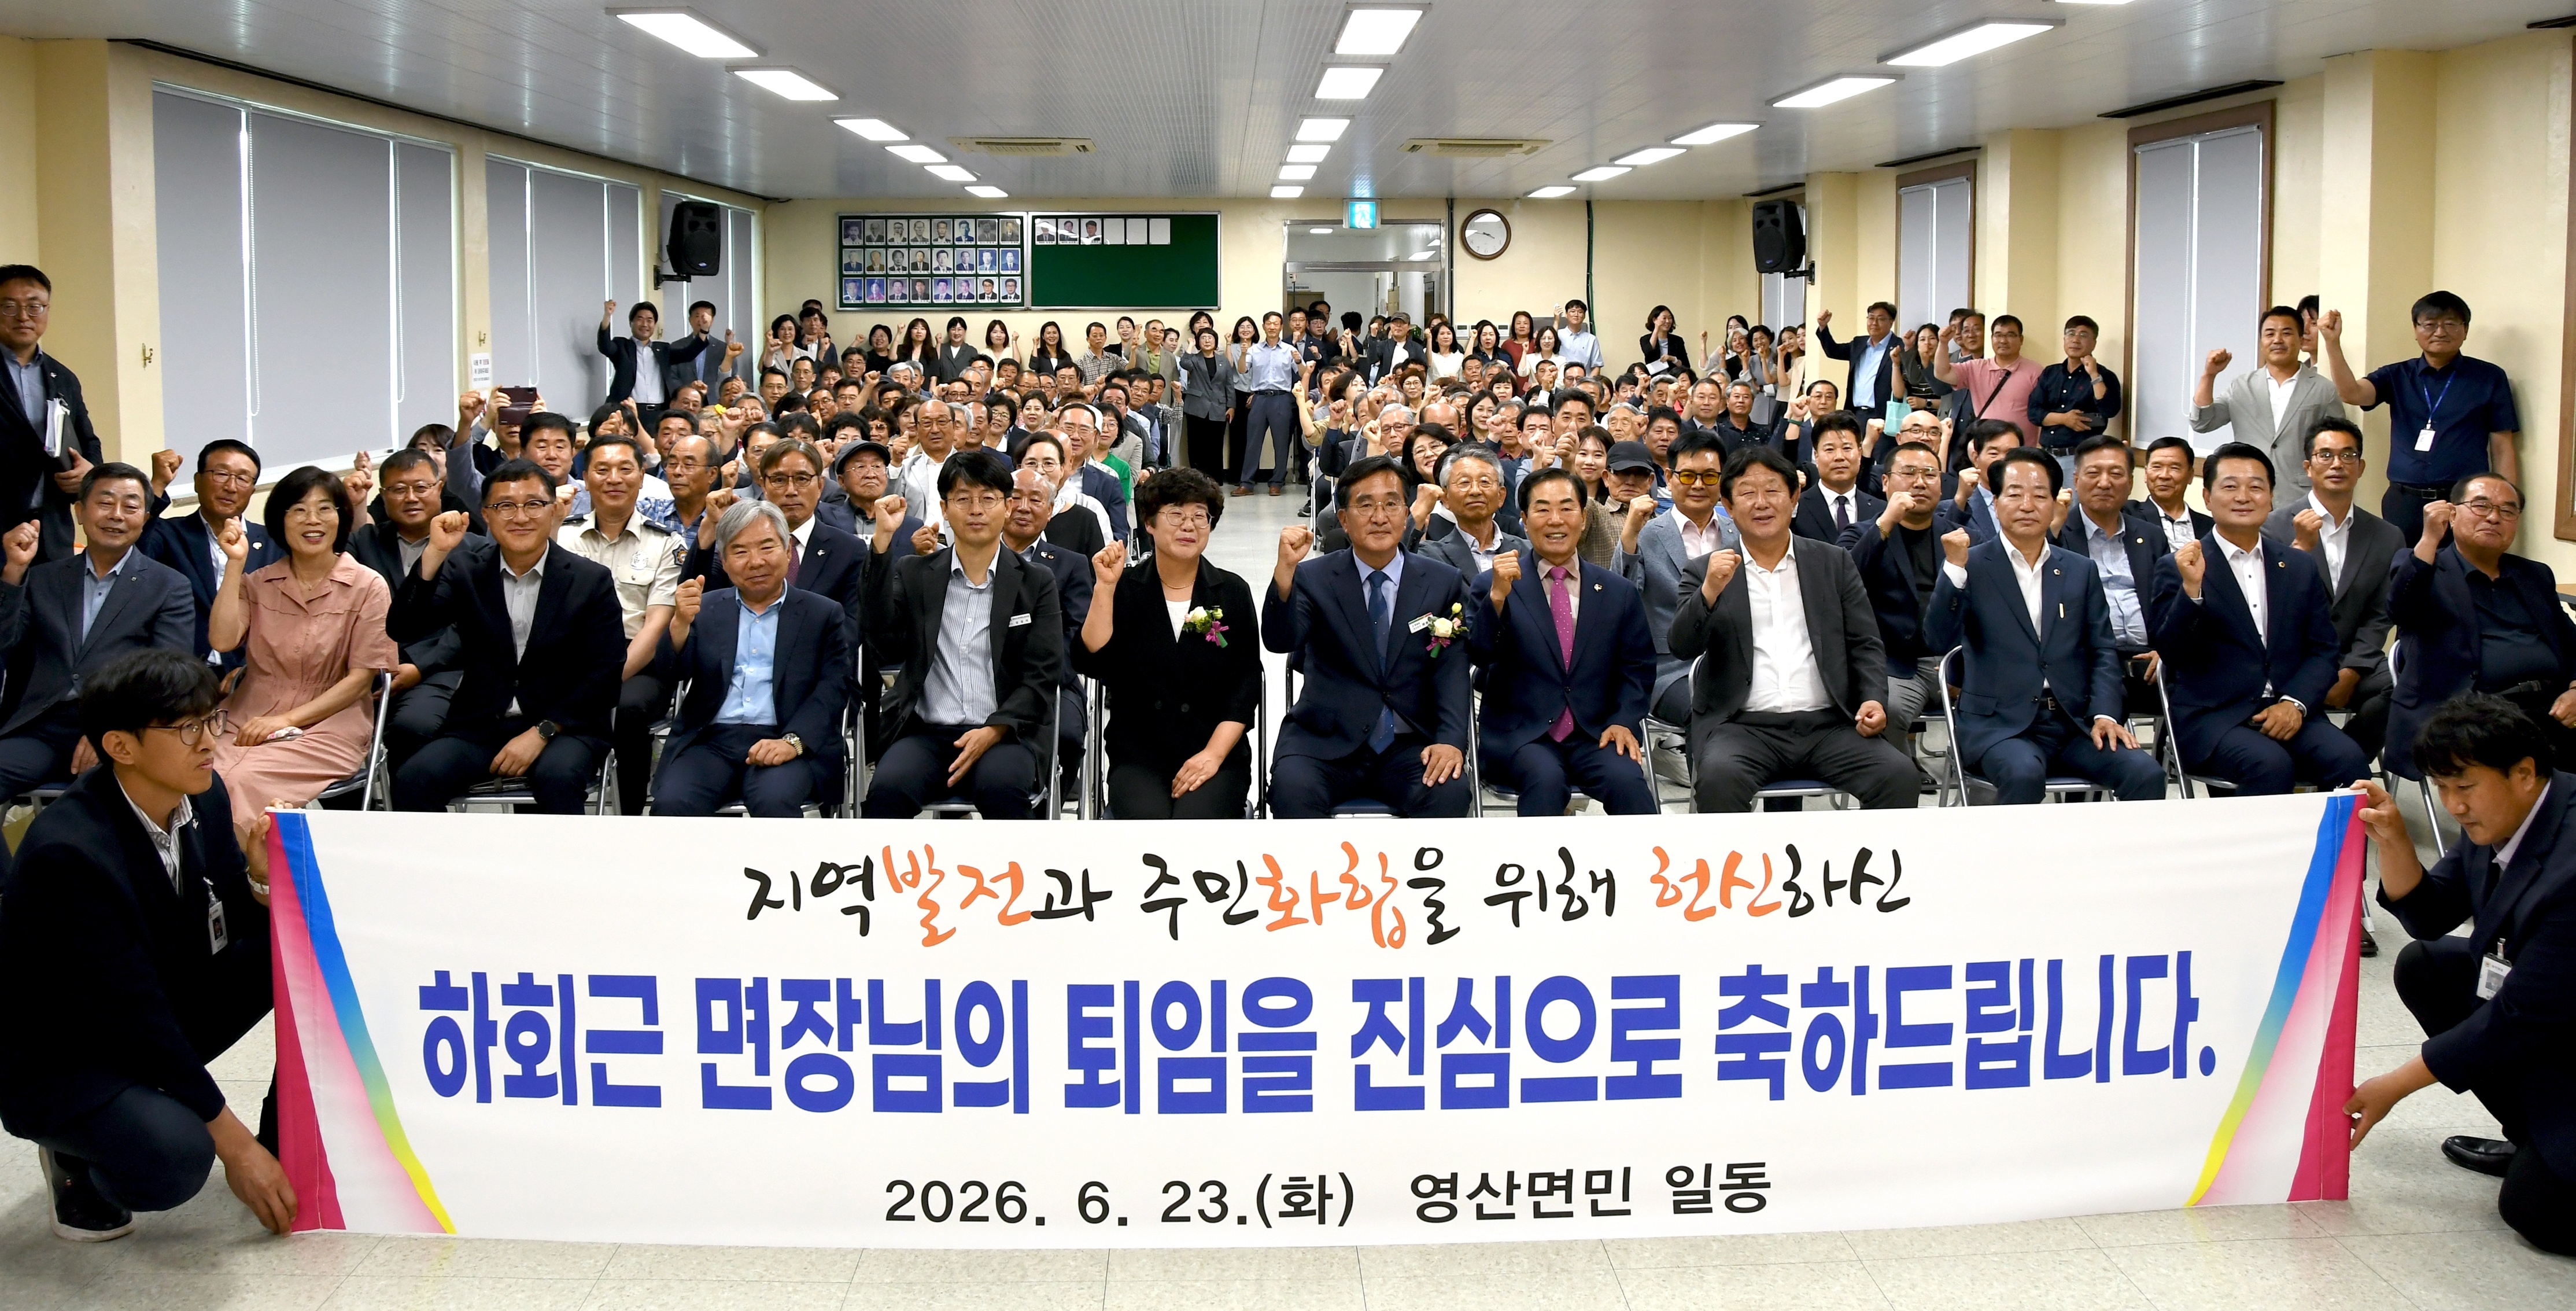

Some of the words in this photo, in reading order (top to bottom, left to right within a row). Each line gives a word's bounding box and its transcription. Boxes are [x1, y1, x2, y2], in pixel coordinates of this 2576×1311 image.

[744, 844, 1113, 947] 지역발전과
[1140, 841, 1460, 949] 주민화합을
[1483, 846, 1616, 928] 위해
[1650, 844, 1911, 922] 헌신하신
[419, 970, 663, 1108] 하회근
[695, 977, 1029, 1114] 면장님의
[1064, 977, 1317, 1114] 퇴임을
[1350, 974, 1682, 1111] 진심으로
[1714, 950, 2216, 1101] 축하드립니다.
[885, 1180, 1045, 1226] 2026.
[1077, 1181, 1128, 1227] 6.
[1161, 1172, 1354, 1229] 23.(화)
[1411, 1166, 1632, 1224] 영산면민
[1665, 1162, 1771, 1214] 일동
